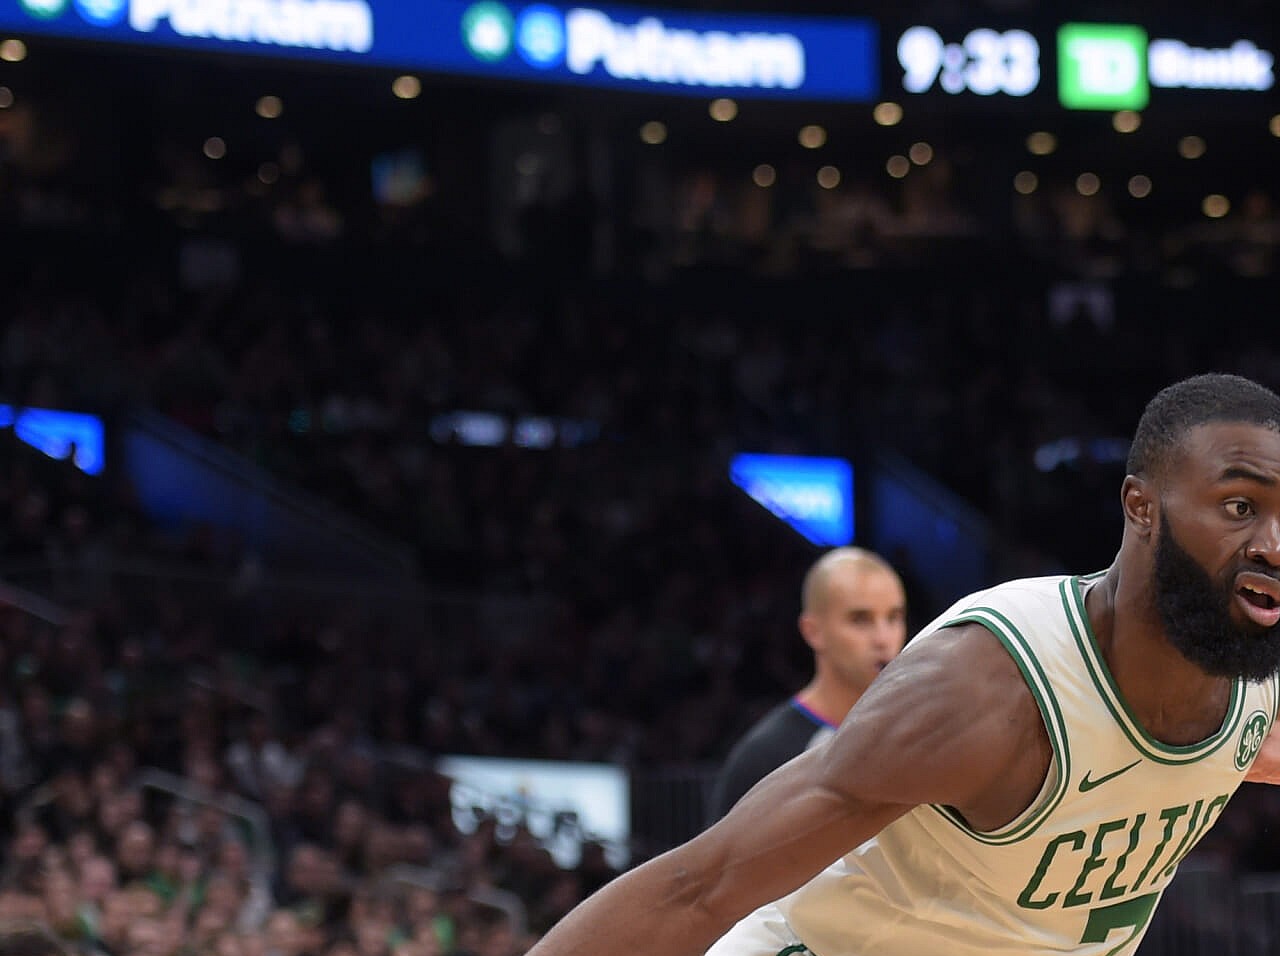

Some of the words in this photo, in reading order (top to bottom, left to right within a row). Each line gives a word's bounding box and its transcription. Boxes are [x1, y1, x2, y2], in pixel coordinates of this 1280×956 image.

[566, 8, 804, 89] Putnam
[897, 26, 1040, 97] 9:33
[1016, 792, 1229, 911] CELTIC
